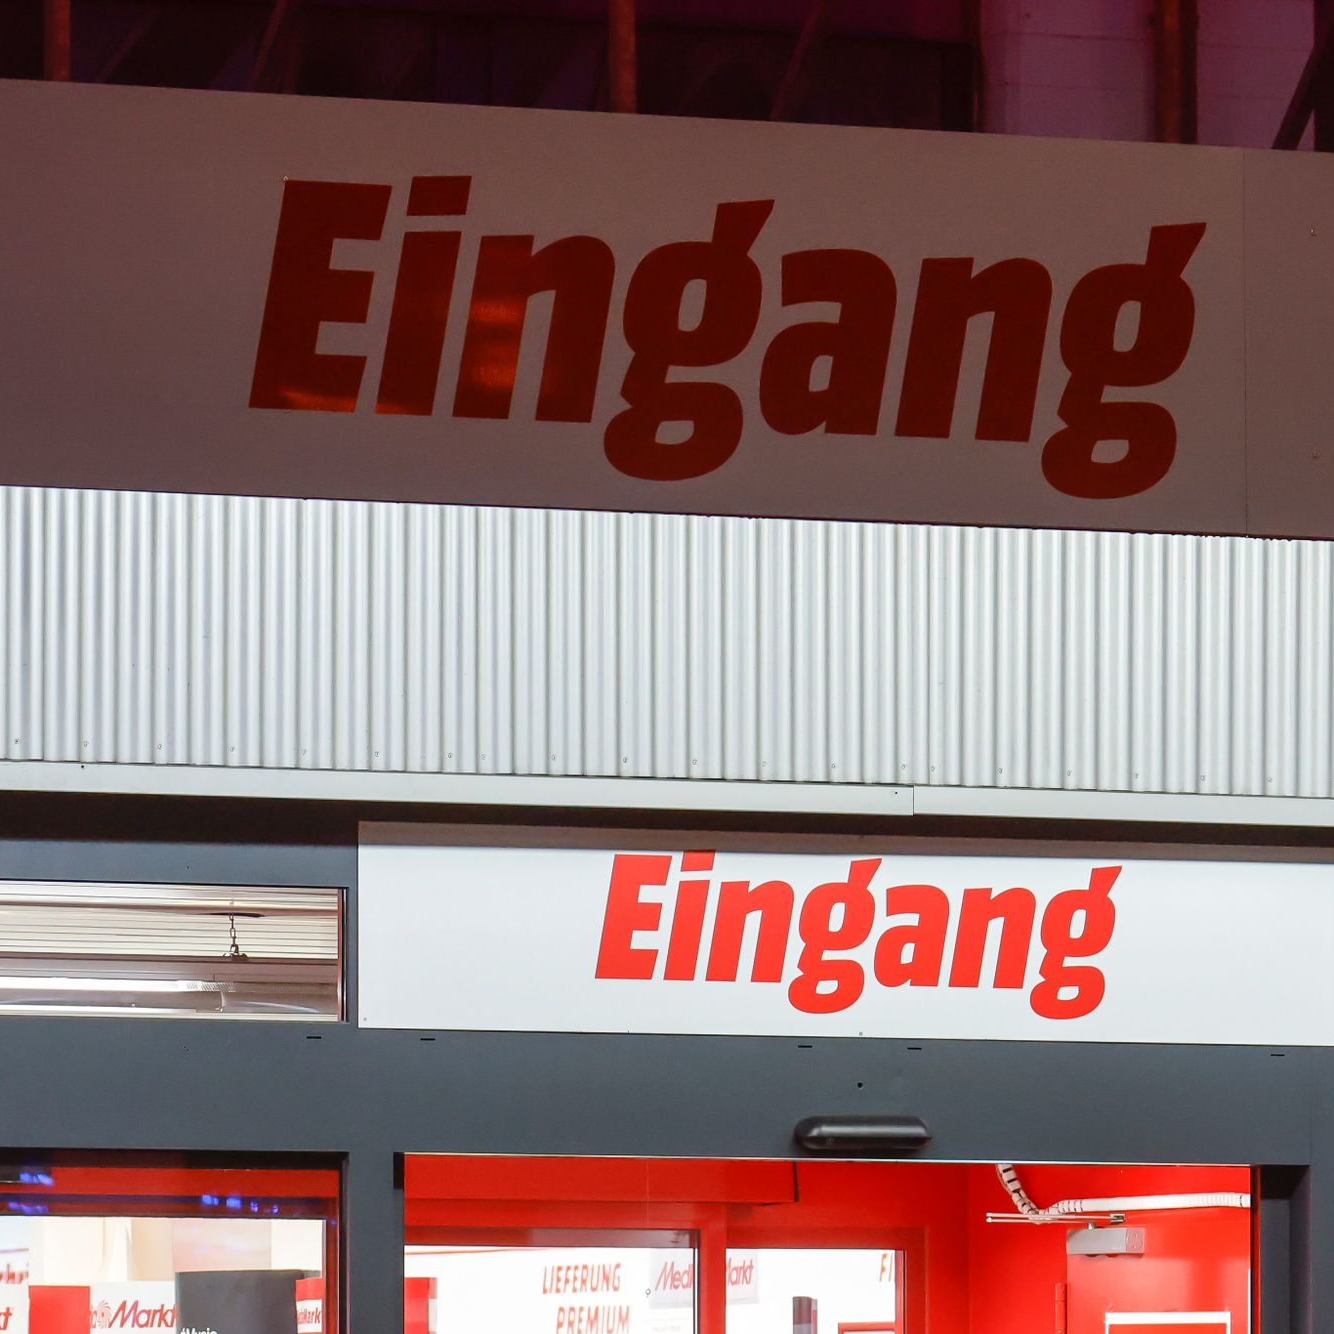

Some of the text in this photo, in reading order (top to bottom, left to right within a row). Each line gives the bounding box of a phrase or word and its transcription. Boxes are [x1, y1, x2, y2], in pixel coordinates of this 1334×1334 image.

[248, 175, 1206, 500] Eingang
[594, 850, 1122, 1020] Eingang
[542, 1263, 621, 1295] LIEFERUNG
[556, 1305, 630, 1334] PREMIUM
